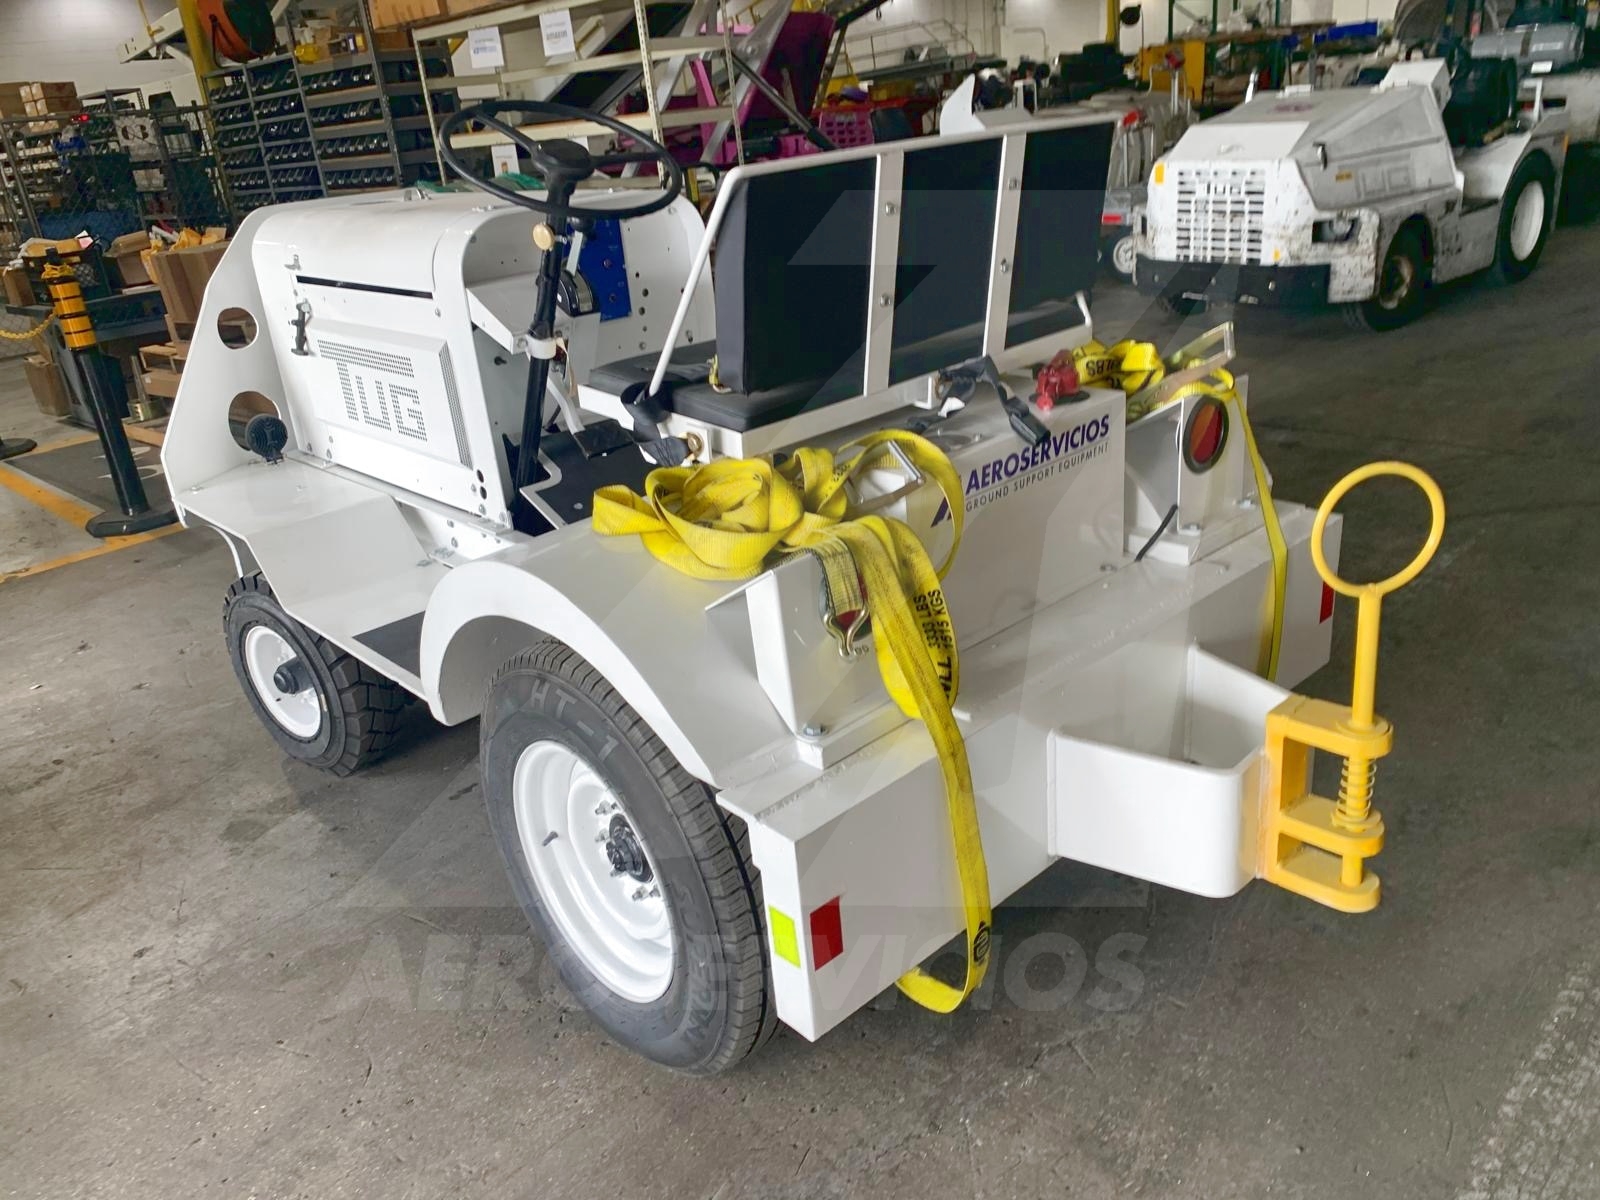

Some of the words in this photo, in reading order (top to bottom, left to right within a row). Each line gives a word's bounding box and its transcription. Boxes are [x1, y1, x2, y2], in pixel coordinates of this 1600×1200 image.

[317, 339, 428, 442] TUG
[965, 486, 1009, 513] GROUND
[1013, 468, 1055, 492] SUPPORT
[1058, 442, 1110, 473] EQUIPMENT
[966, 413, 1110, 496] AEROSERVICIOS
[913, 594, 932, 619] LBS
[928, 589, 947, 617] KGS
